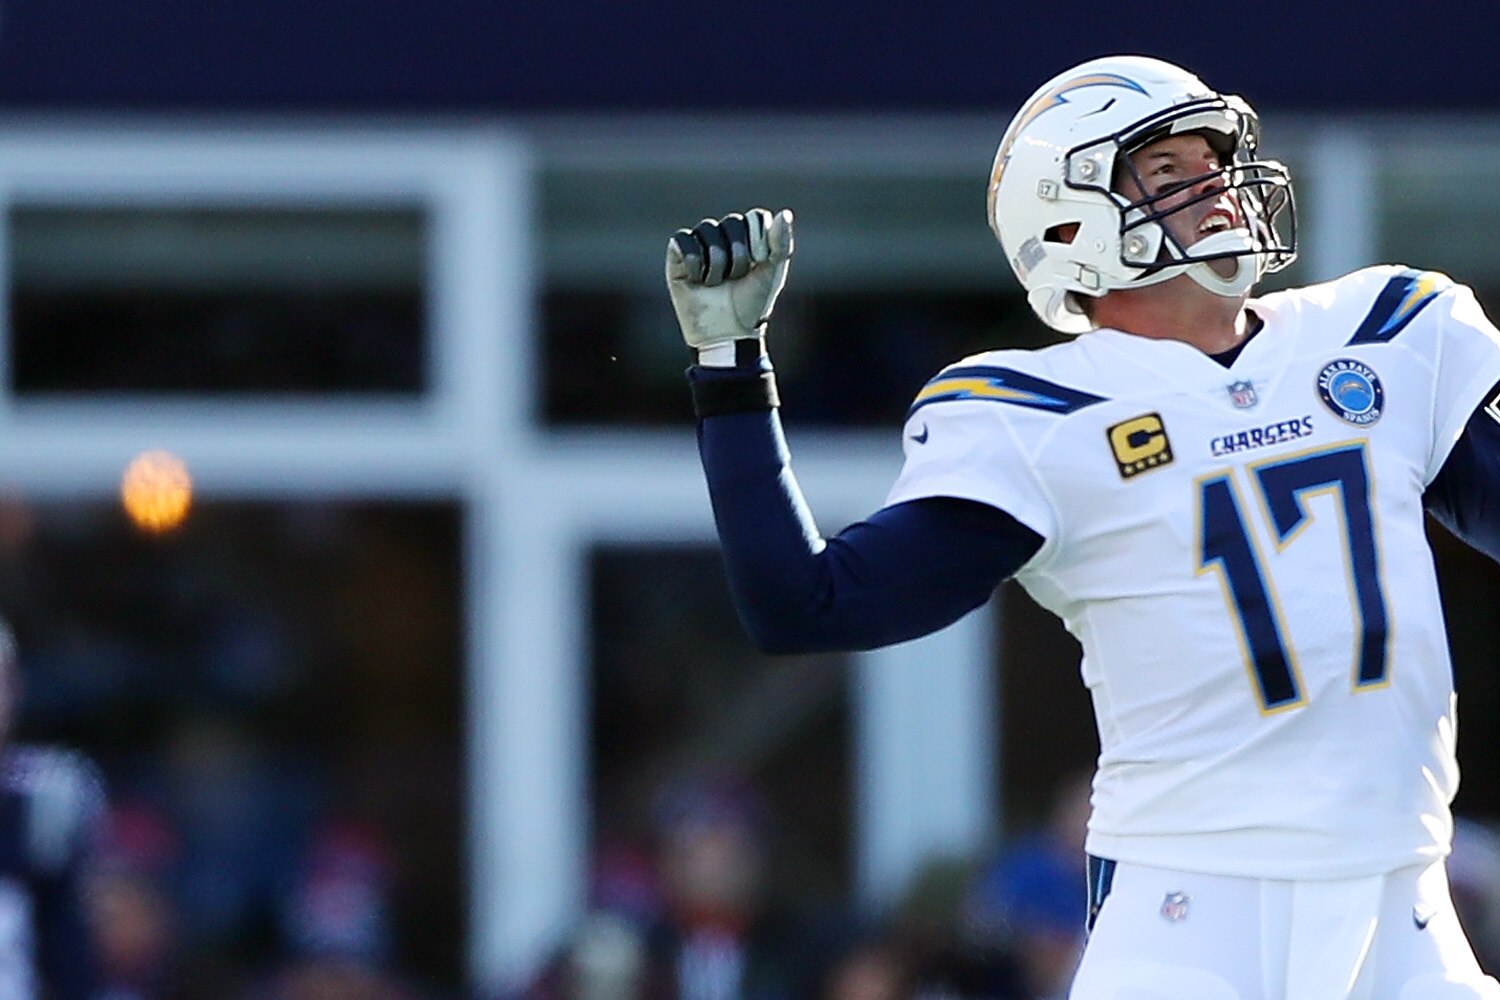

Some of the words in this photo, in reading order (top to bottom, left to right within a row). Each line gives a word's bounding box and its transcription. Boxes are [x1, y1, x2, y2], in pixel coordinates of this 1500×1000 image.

[1110, 416, 1166, 464] C
[1210, 415, 1313, 457] CHARGERS
[1192, 437, 1393, 717] 17
